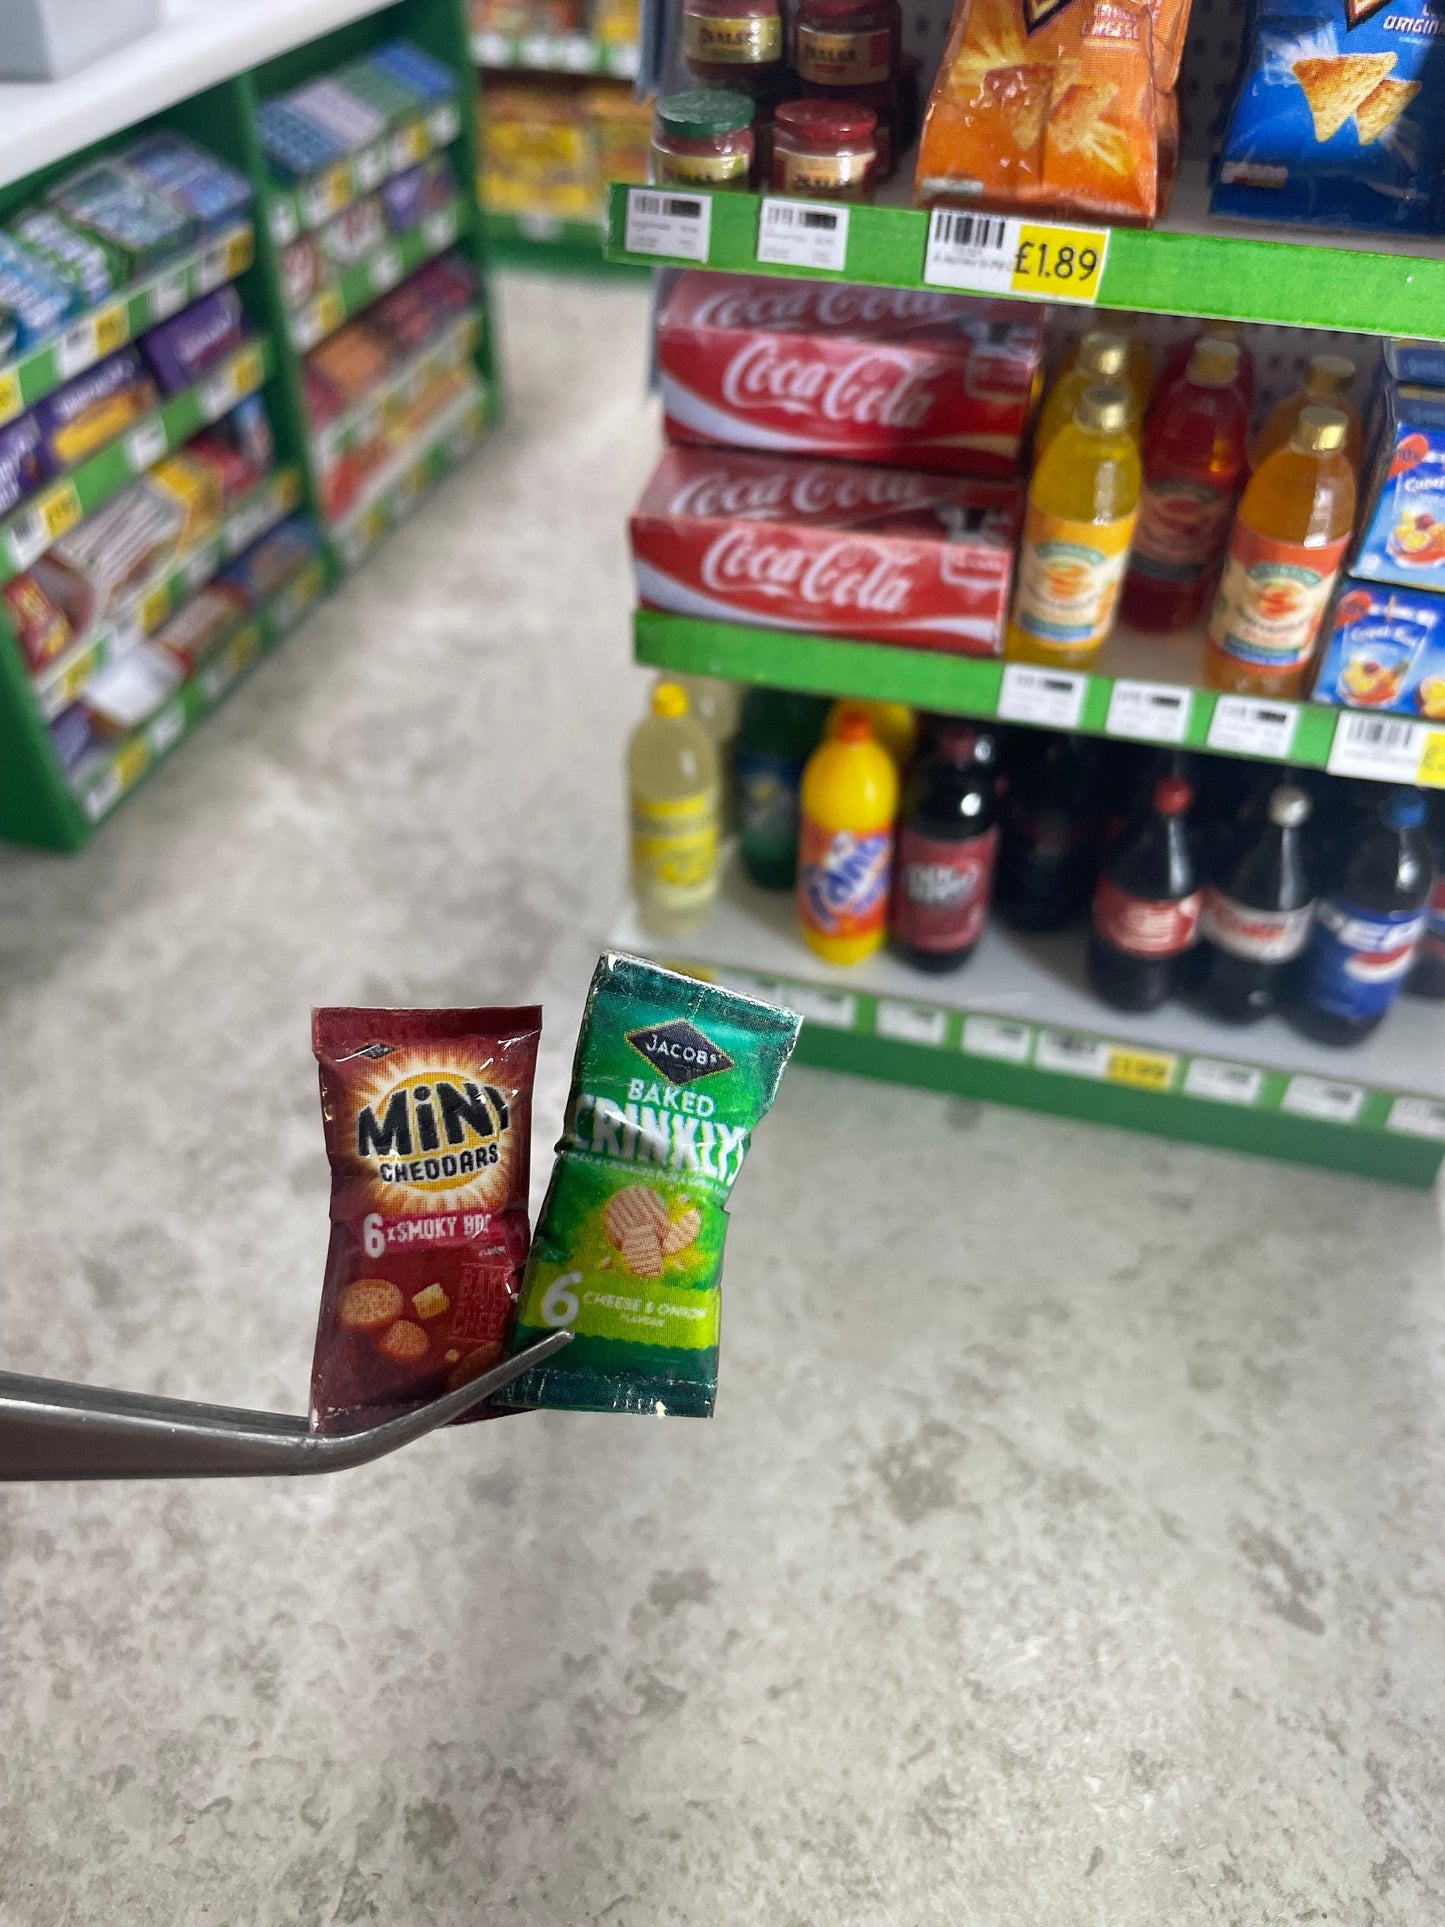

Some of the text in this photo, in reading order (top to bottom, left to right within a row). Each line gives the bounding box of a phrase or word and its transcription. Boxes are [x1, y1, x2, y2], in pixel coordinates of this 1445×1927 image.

[1015, 242, 1098, 281] £1.89
[627, 1077, 715, 1117] BAKED
[379, 1143, 499, 1182] CHEDDARS
[541, 1271, 583, 1327] 6
